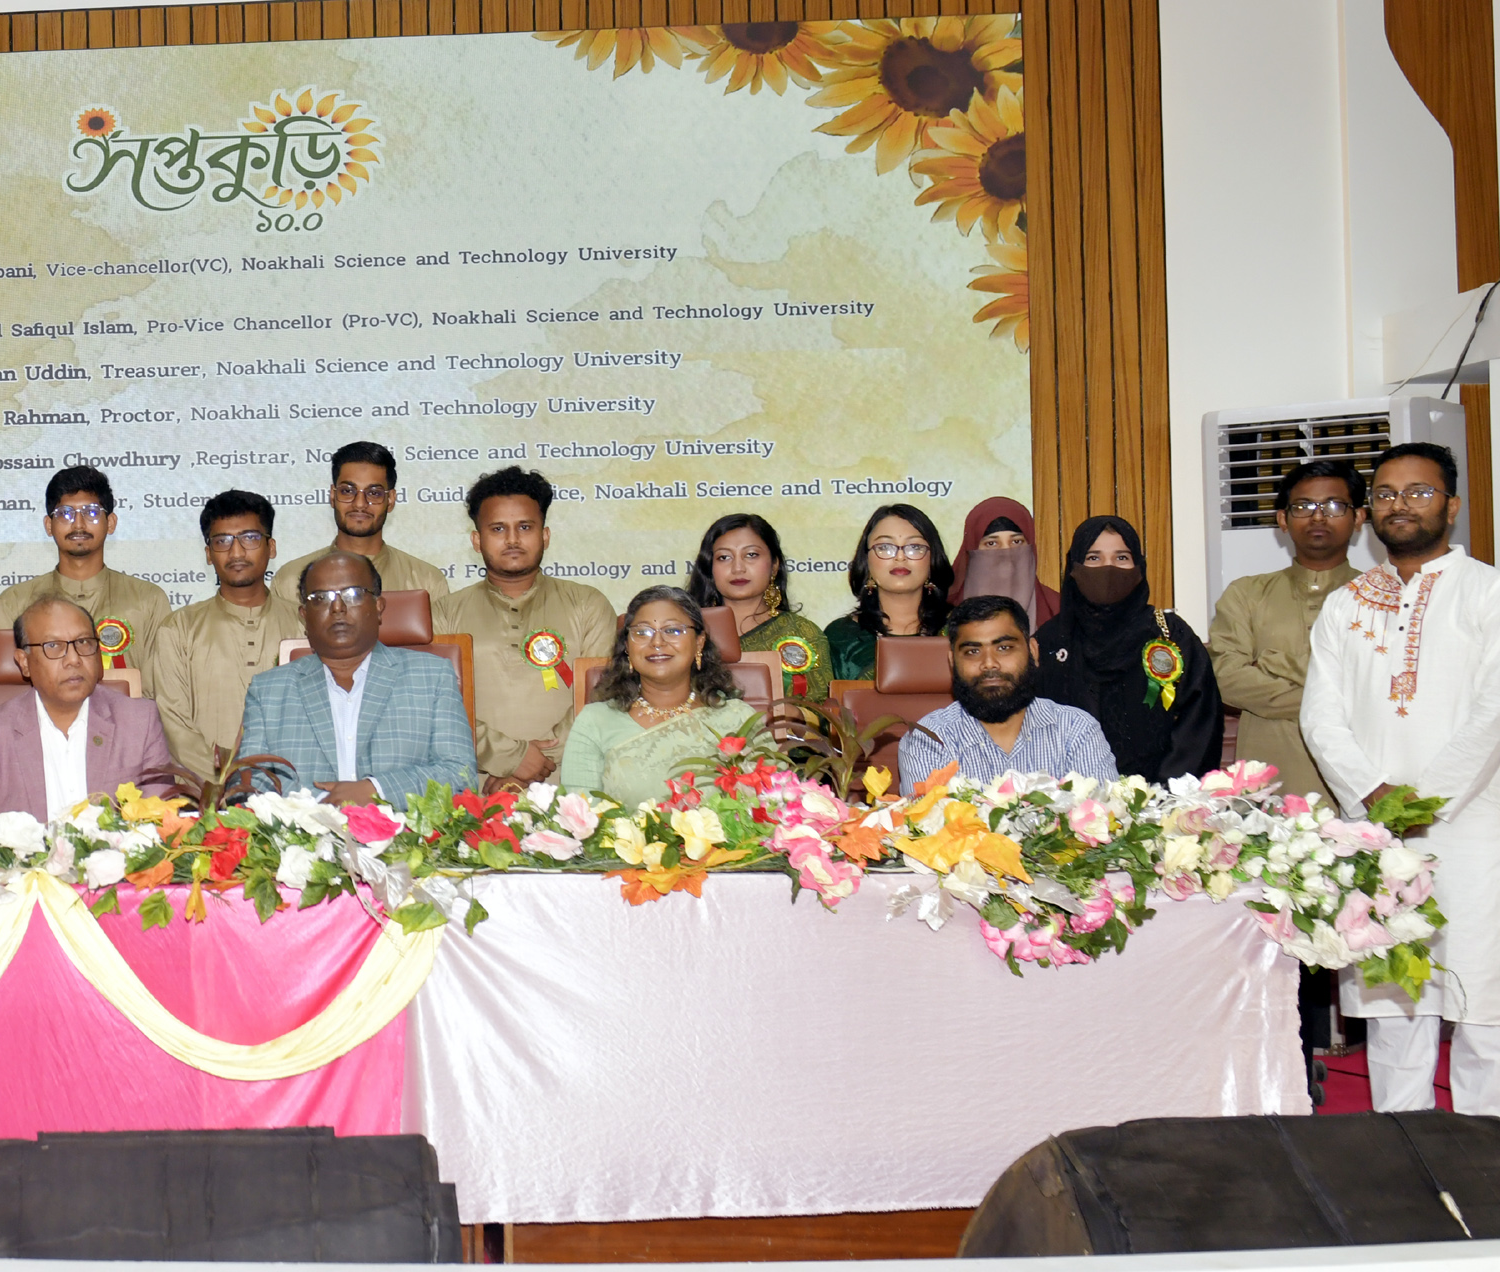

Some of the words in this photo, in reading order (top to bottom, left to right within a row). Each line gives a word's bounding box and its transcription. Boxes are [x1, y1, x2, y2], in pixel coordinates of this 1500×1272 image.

[46, 256, 232, 277] Vice-chancellor(VC),
[241, 254, 325, 271] Noakhali
[334, 253, 406, 269] Science
[415, 251, 450, 266] and
[458, 248, 569, 266] Technology
[578, 244, 678, 262] University
[11, 321, 75, 339] Safiqul
[83, 320, 138, 336] Islam,
[146, 317, 225, 334] Pro-Vice
[233, 314, 333, 331] Chancellor
[342, 311, 423, 331] (Pro-VC),
[432, 309, 517, 326] Noakhali
[526, 308, 600, 323] Science
[609, 305, 644, 321] and
[652, 303, 764, 321] Technology
[773, 300, 875, 318] University
[24, 363, 92, 382] Uddin,
[100, 364, 206, 379] Treasurer,
[216, 358, 307, 376] Noakhali
[315, 357, 389, 374] Science
[397, 354, 436, 372] and
[445, 352, 564, 373] Technology
[573, 349, 682, 369] University
[3, 408, 91, 426] Rahman,
[100, 408, 181, 424] Proctor,
[190, 403, 281, 421] Noakhali
[289, 403, 363, 419] Science
[371, 400, 410, 417] and
[419, 398, 538, 419] Technology
[547, 395, 656, 415] University
[63, 451, 181, 470] Chowdhury
[405, 445, 479, 461] Science
[487, 442, 527, 460] and
[536, 440, 656, 461] Technology
[665, 438, 774, 458] University
[143, 492, 219, 508] Studen
[594, 481, 688, 500] Noakhali
[696, 481, 773, 498] Science
[781, 479, 822, 496] and
[830, 477, 953, 497] Technology
[543, 561, 631, 579] chnology
[641, 559, 677, 576] and
